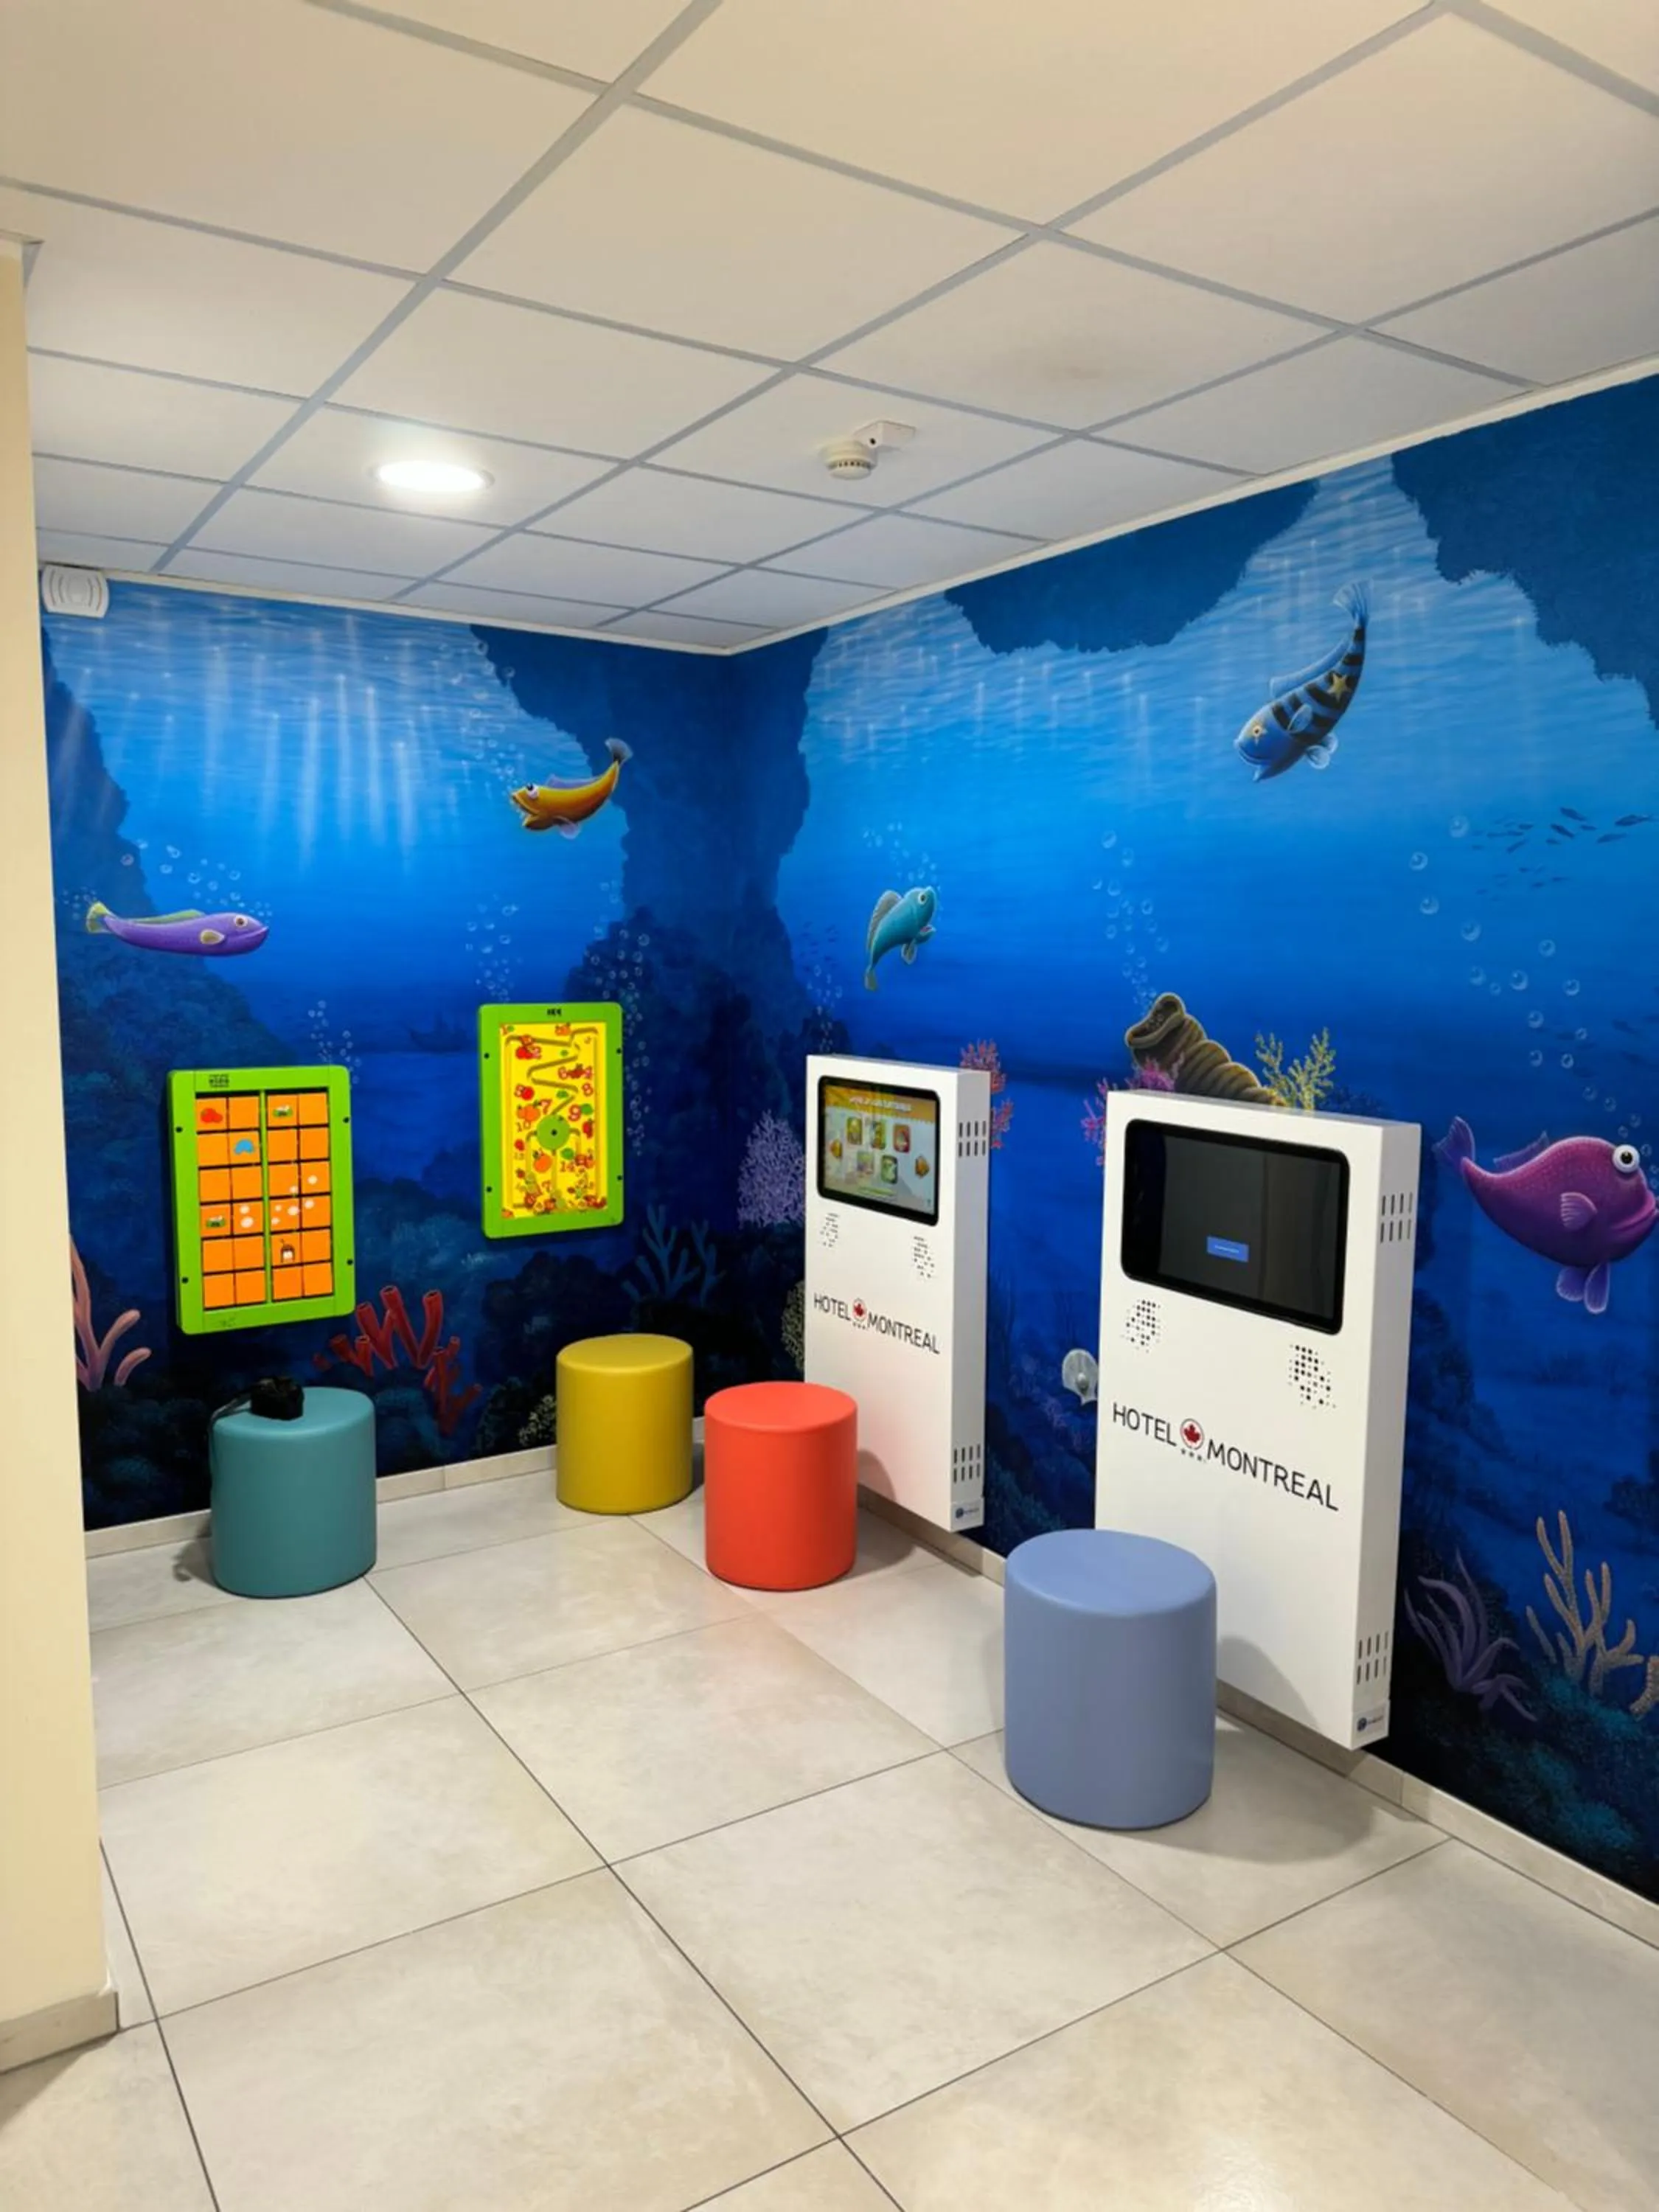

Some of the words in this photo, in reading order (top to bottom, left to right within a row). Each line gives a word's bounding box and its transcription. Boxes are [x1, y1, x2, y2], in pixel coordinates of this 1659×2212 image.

[813, 1293, 851, 1321] HOTEL
[866, 1311, 941, 1354] MONTREAL
[1112, 1402, 1178, 1447] HOTEL
[1206, 1439, 1338, 1512] MONTREAL
